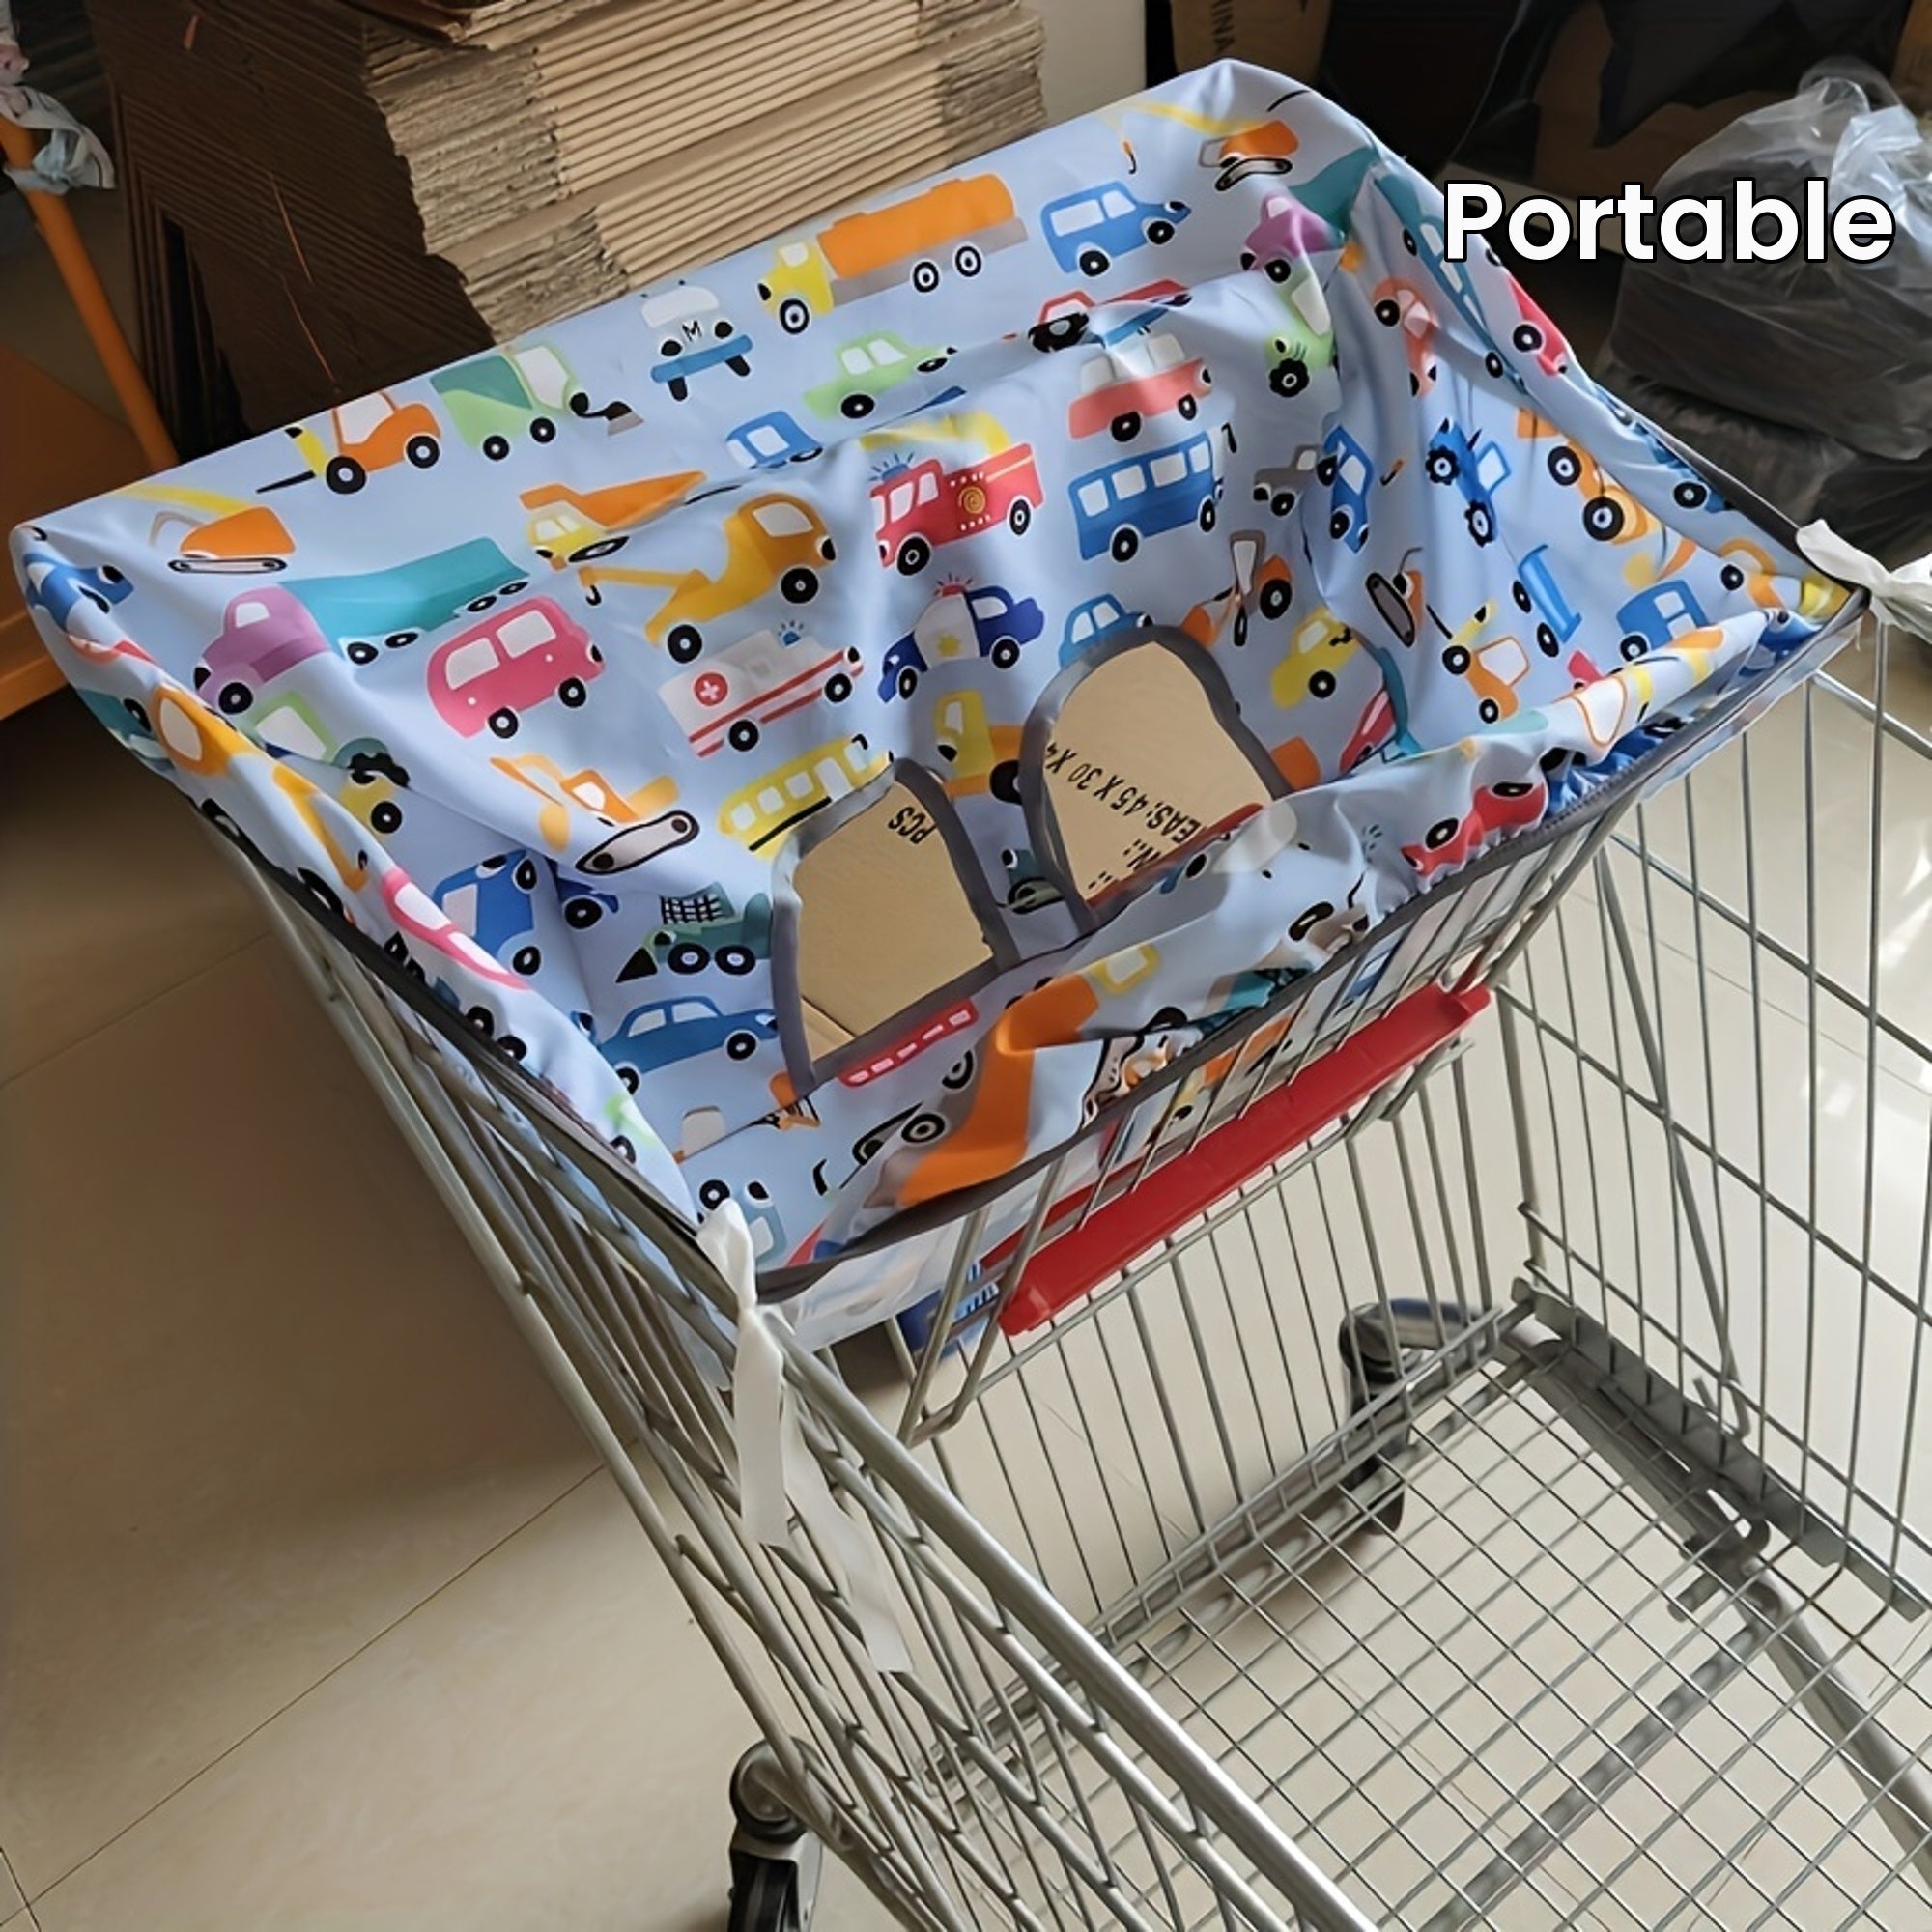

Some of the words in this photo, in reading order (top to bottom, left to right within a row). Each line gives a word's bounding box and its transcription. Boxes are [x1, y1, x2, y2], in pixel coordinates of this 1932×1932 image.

[682, 320, 703, 342] M
[1067, 763, 1103, 790] 30
[1093, 774, 1124, 801] X
[1110, 786, 1148, 817] 45
[888, 806, 937, 844] PCS
